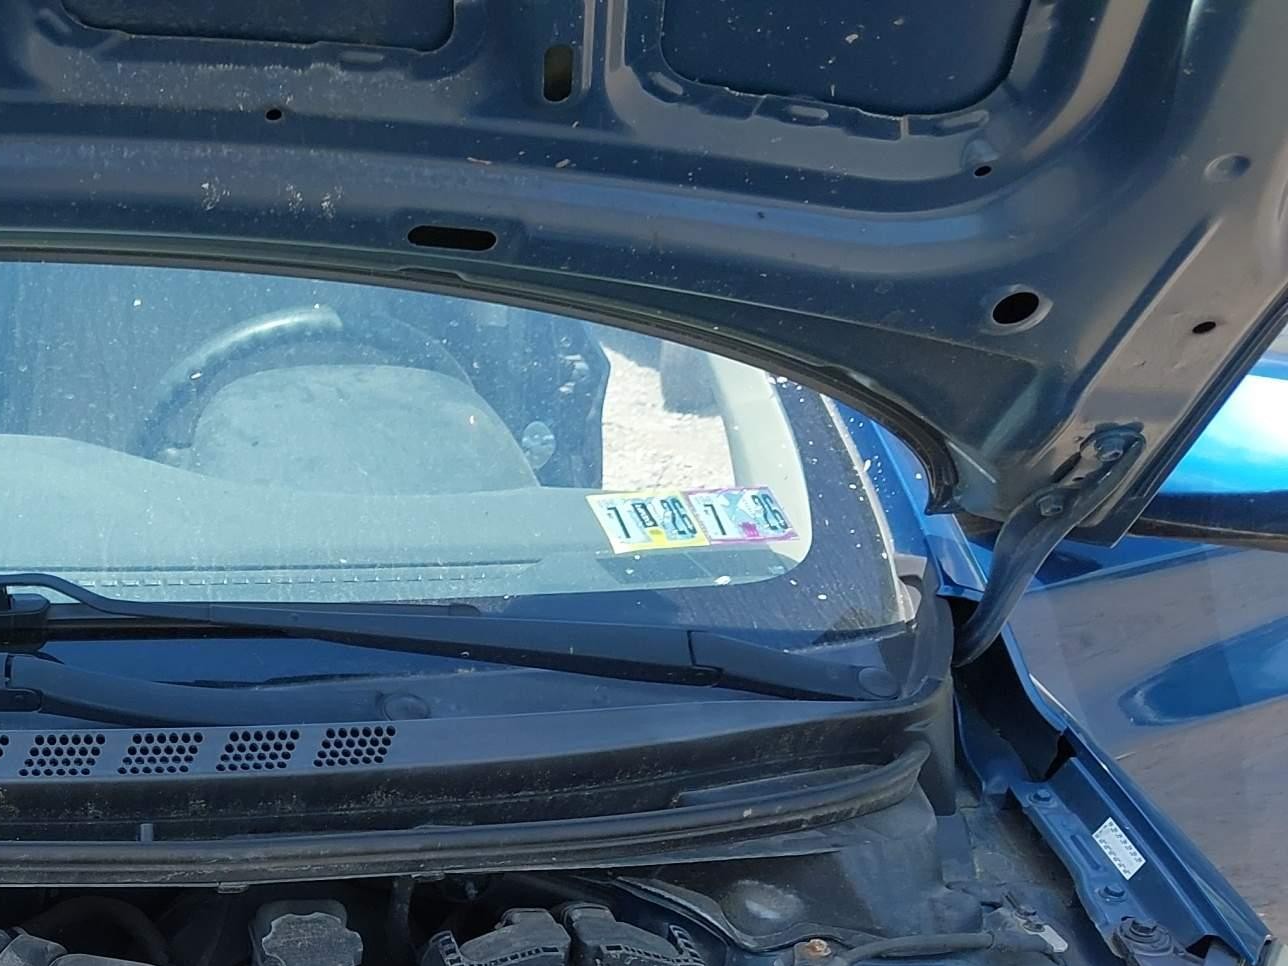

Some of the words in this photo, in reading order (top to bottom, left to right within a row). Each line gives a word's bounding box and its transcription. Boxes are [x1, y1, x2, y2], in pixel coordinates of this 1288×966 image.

[607, 507, 631, 538] 7
[659, 498, 698, 535] 26
[703, 503, 727, 535] 7
[751, 494, 789, 530] 26
